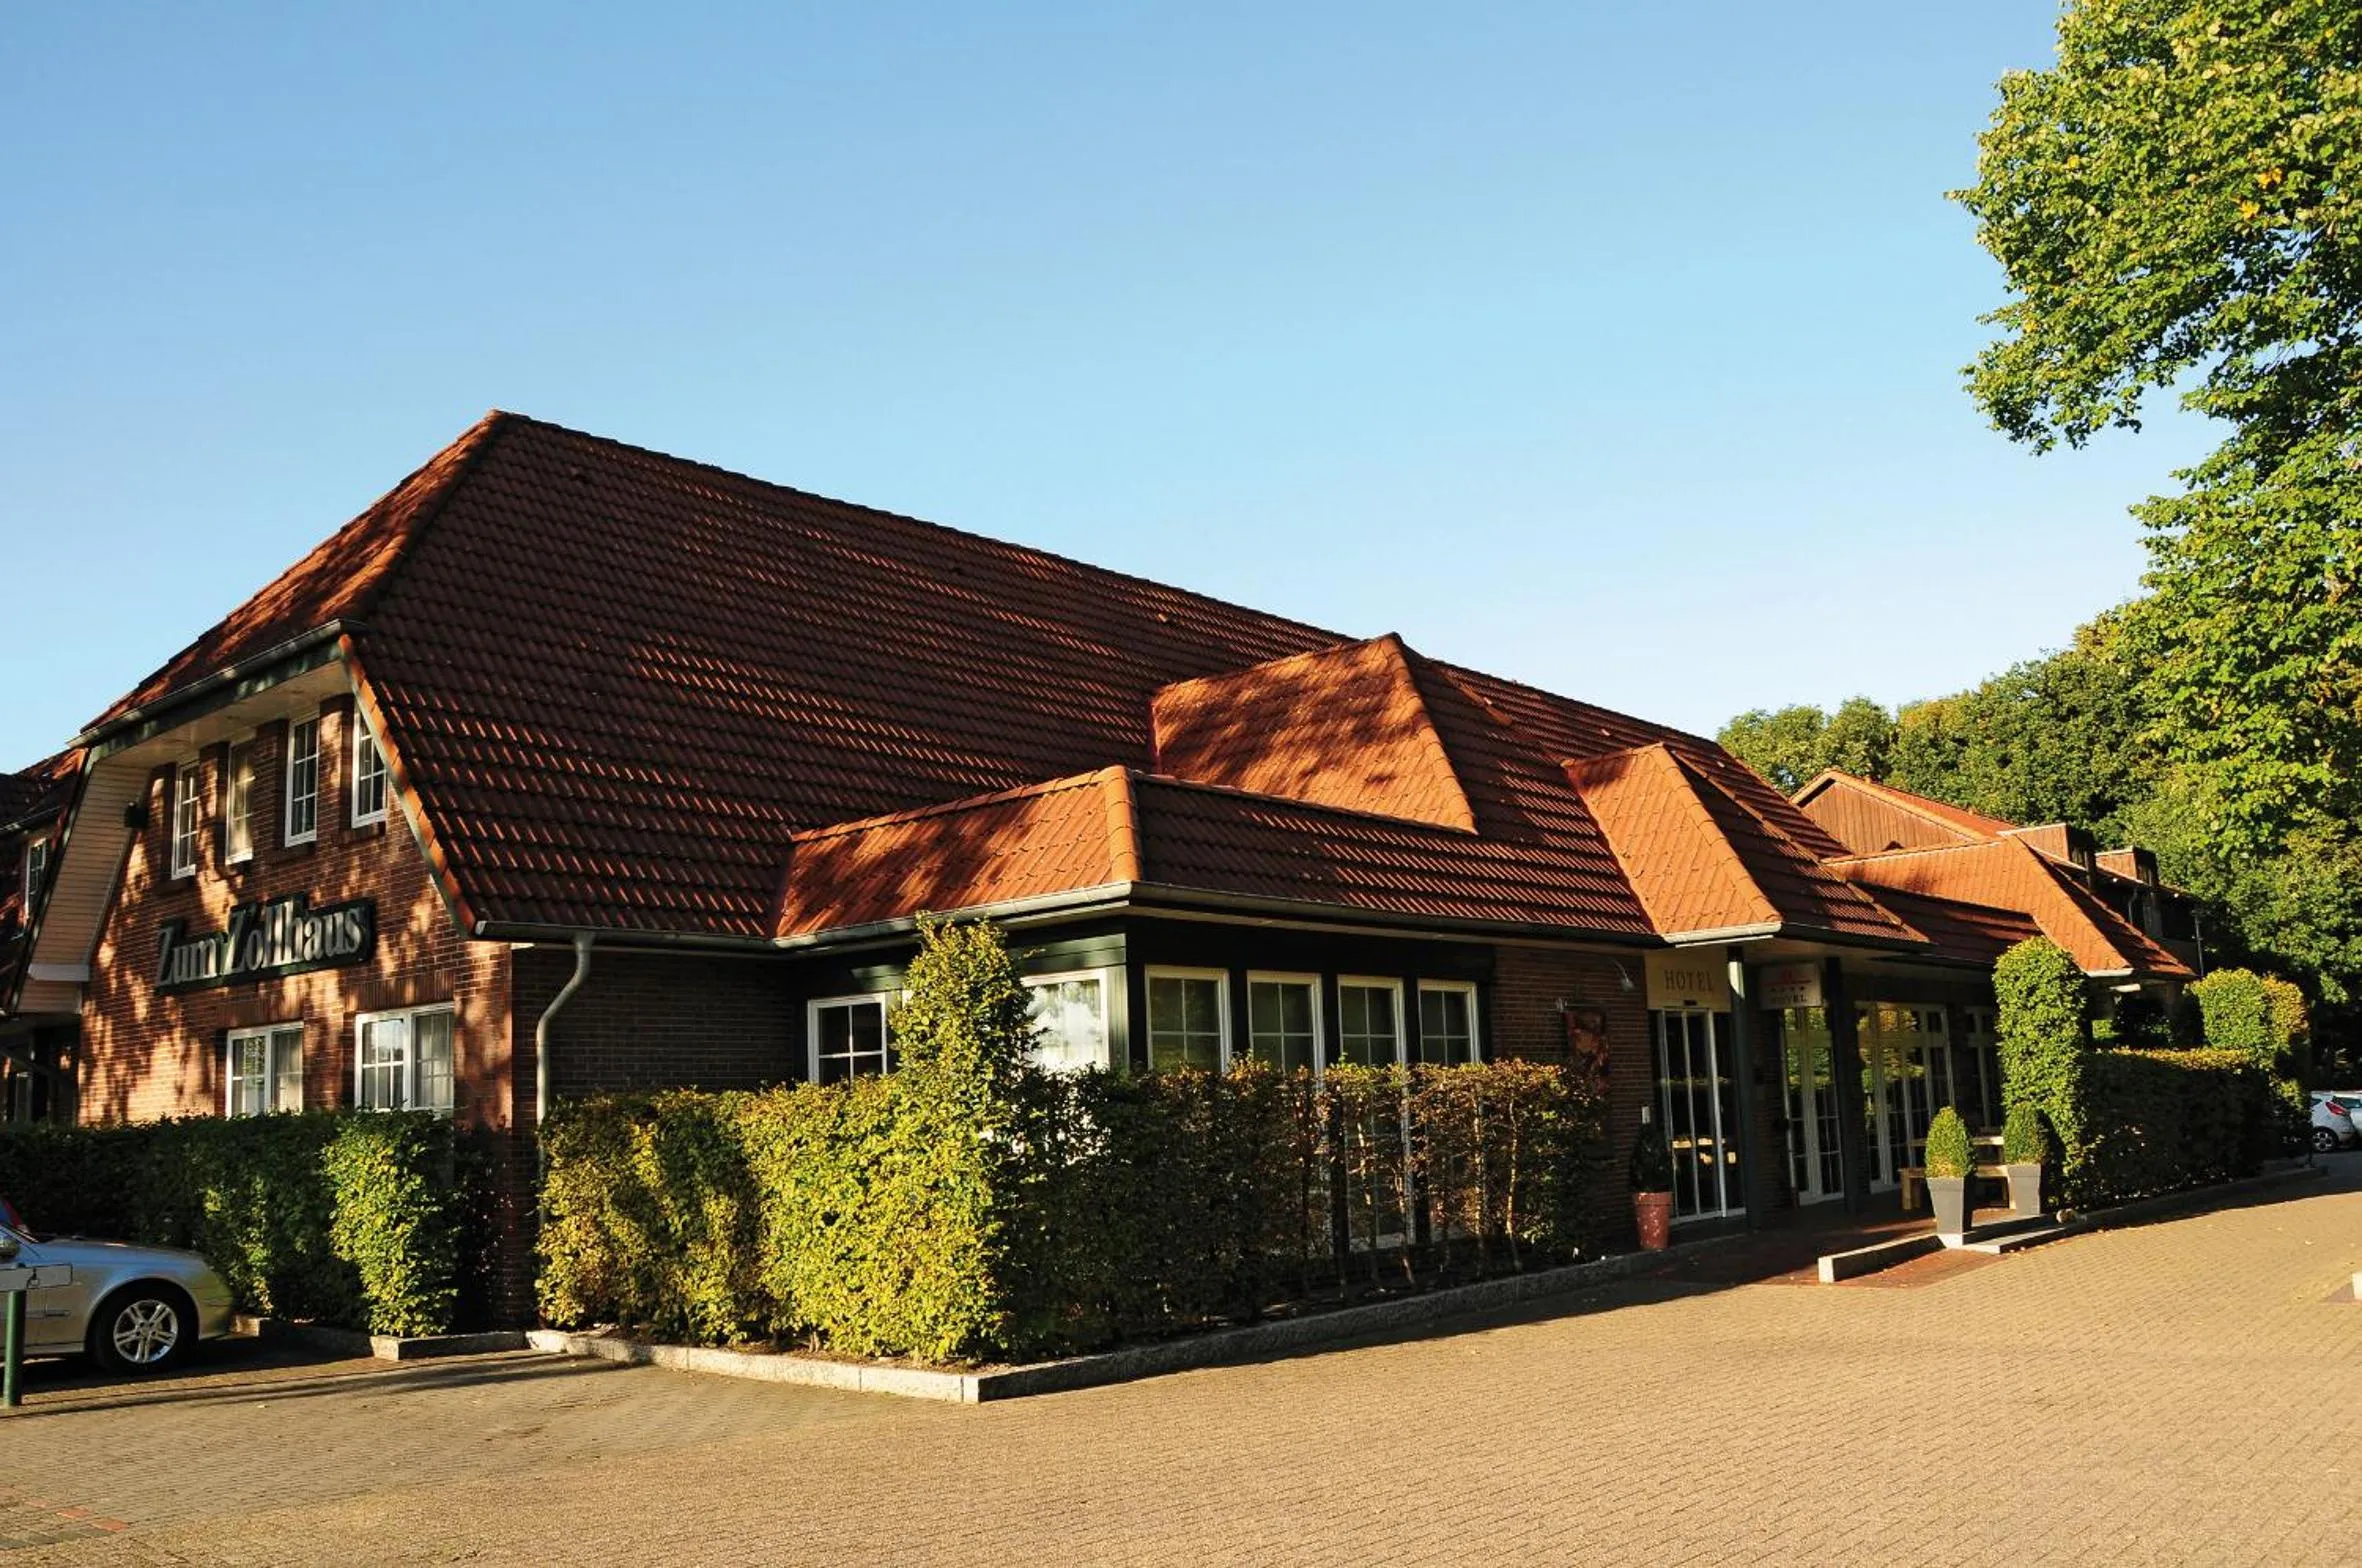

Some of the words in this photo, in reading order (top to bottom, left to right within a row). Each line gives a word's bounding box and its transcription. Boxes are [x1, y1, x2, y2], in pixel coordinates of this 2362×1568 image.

[158, 925, 217, 985] Zum
[222, 899, 363, 976] Zollhaus
[1665, 969, 1714, 993] HOTEL
